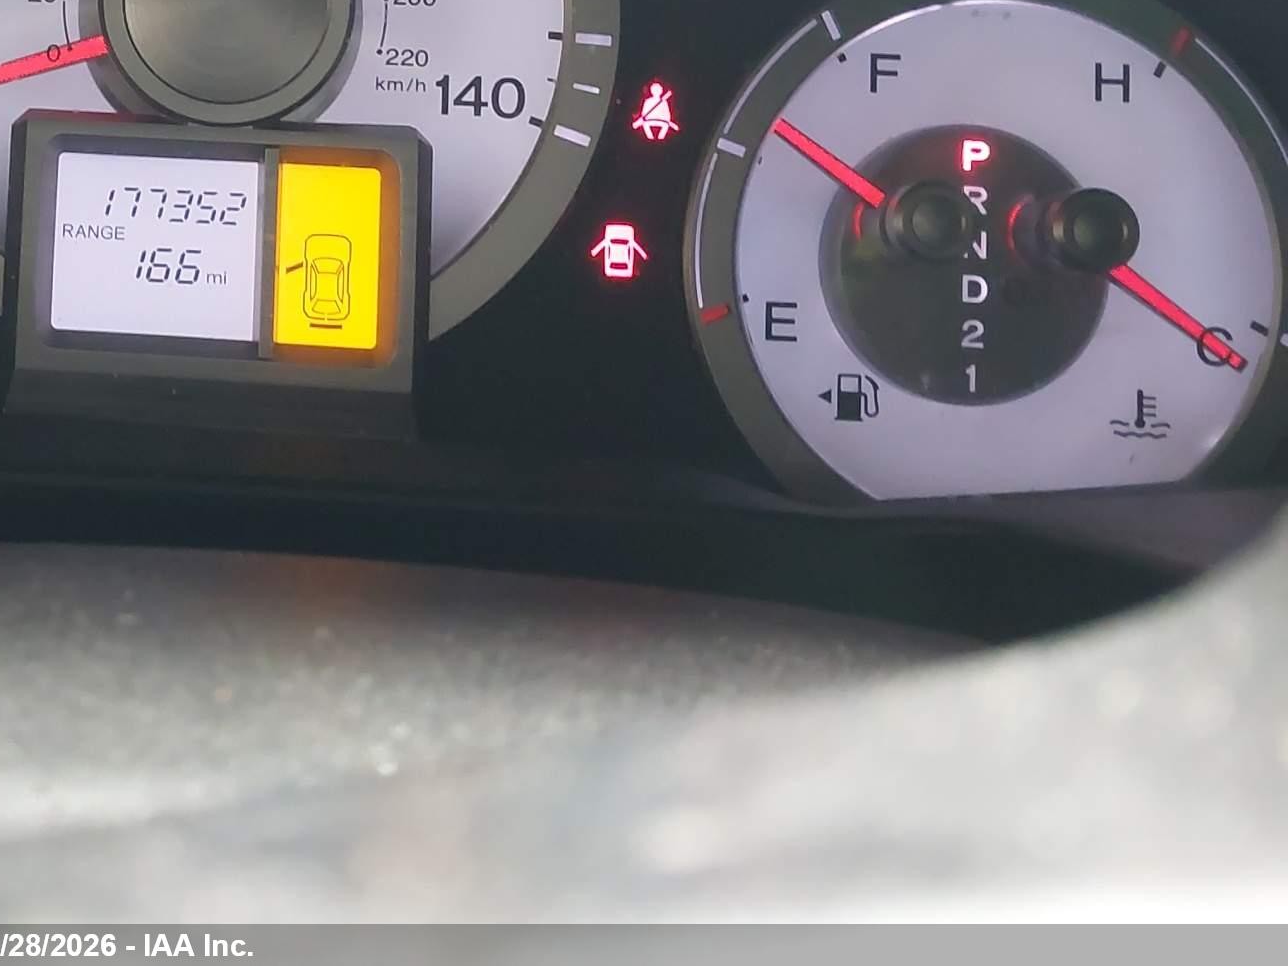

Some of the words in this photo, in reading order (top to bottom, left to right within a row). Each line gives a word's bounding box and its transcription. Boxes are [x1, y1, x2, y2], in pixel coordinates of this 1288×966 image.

[384, 48, 429, 68] 220
[869, 53, 901, 93] F
[374, 75, 427, 94] km/h
[435, 75, 526, 119] 140
[1094, 63, 1130, 103] H
[962, 139, 991, 171] P
[104, 186, 247, 226] 177352
[963, 185, 989, 216] R
[62, 223, 126, 241] RANGE
[135, 247, 202, 284] 166
[206, 270, 227, 286] mi
[961, 274, 989, 304] D
[765, 302, 797, 342] E
[961, 320, 985, 349] 2
[1196, 326, 1233, 367] C
[965, 364, 977, 393] 1
